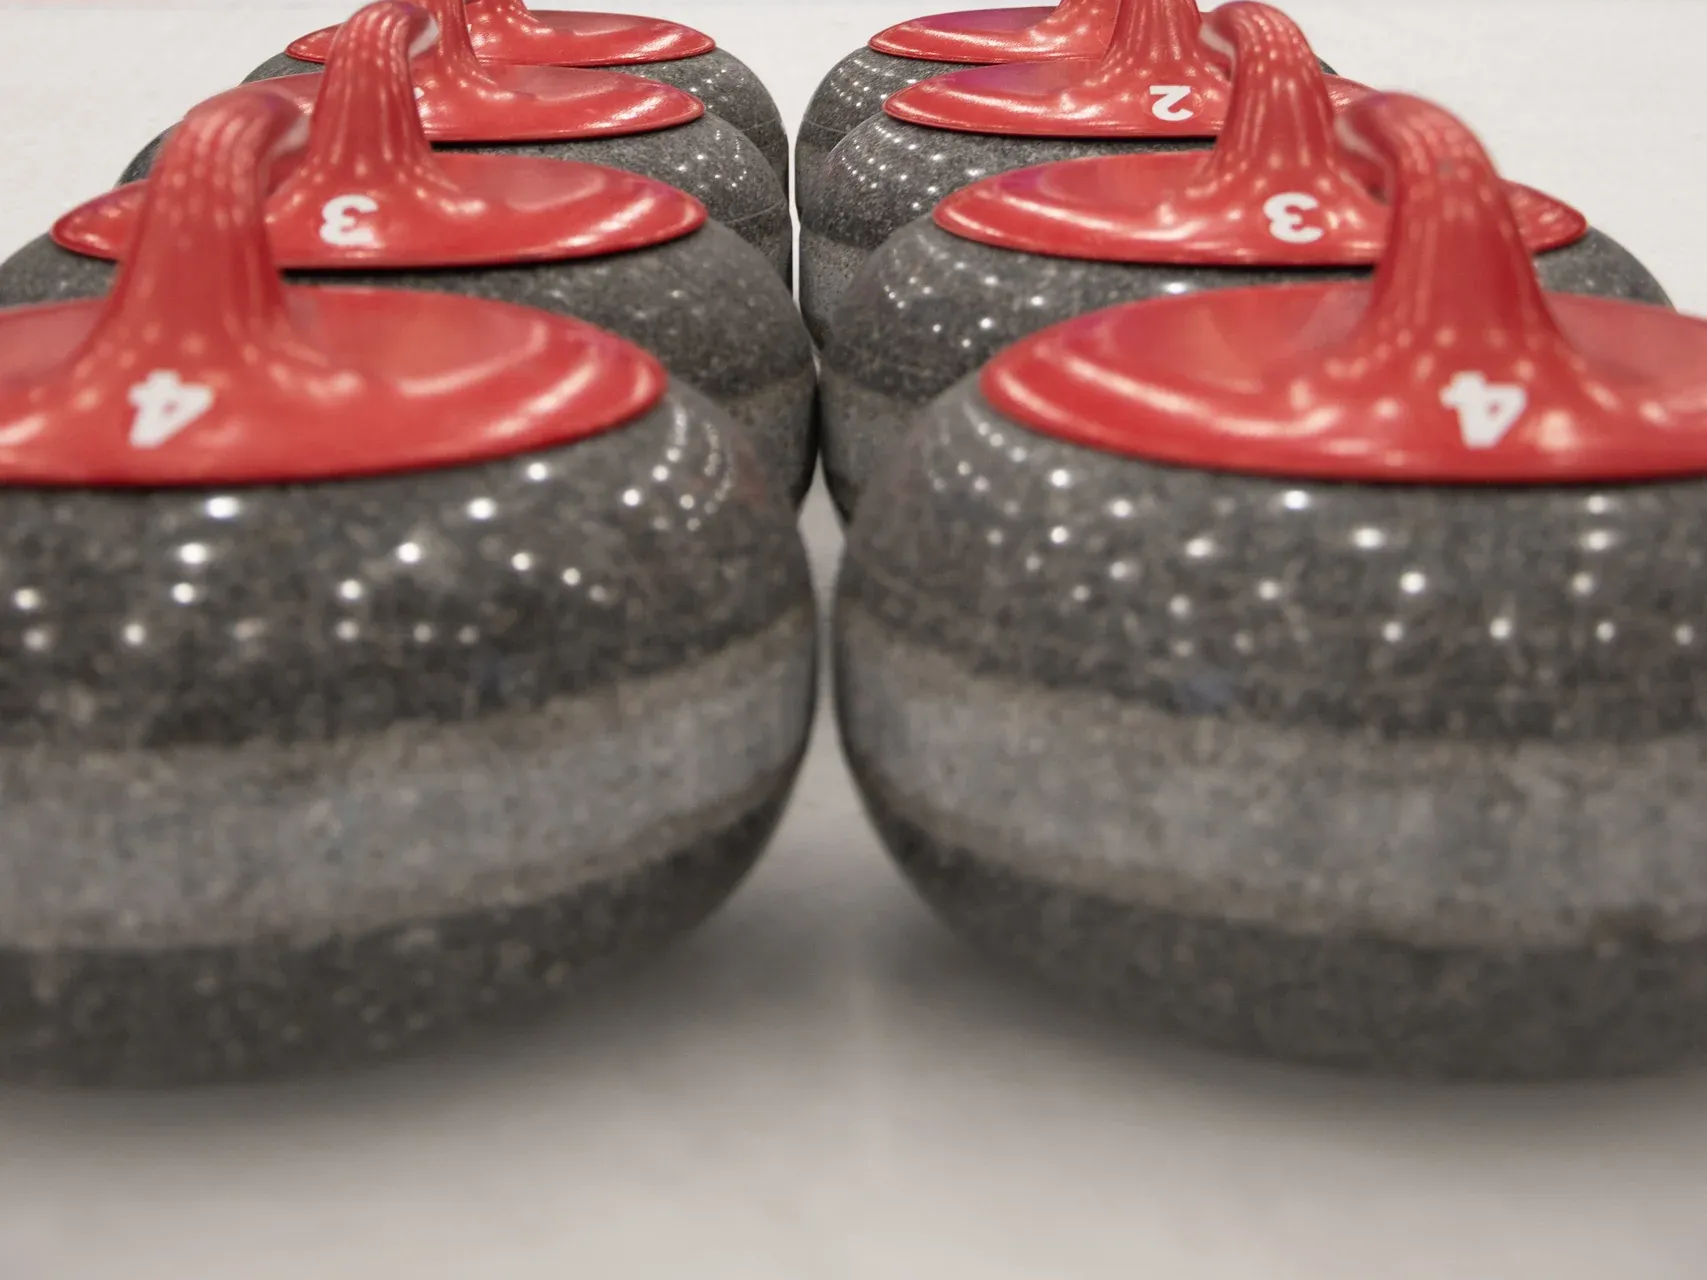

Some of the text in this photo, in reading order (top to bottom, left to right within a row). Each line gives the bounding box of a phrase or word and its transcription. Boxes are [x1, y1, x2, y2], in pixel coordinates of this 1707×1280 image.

[1149, 85, 1194, 123] 2
[319, 194, 381, 249] 3
[1262, 192, 1323, 244] 3
[128, 370, 214, 448] 4
[1440, 372, 1527, 447] 4
